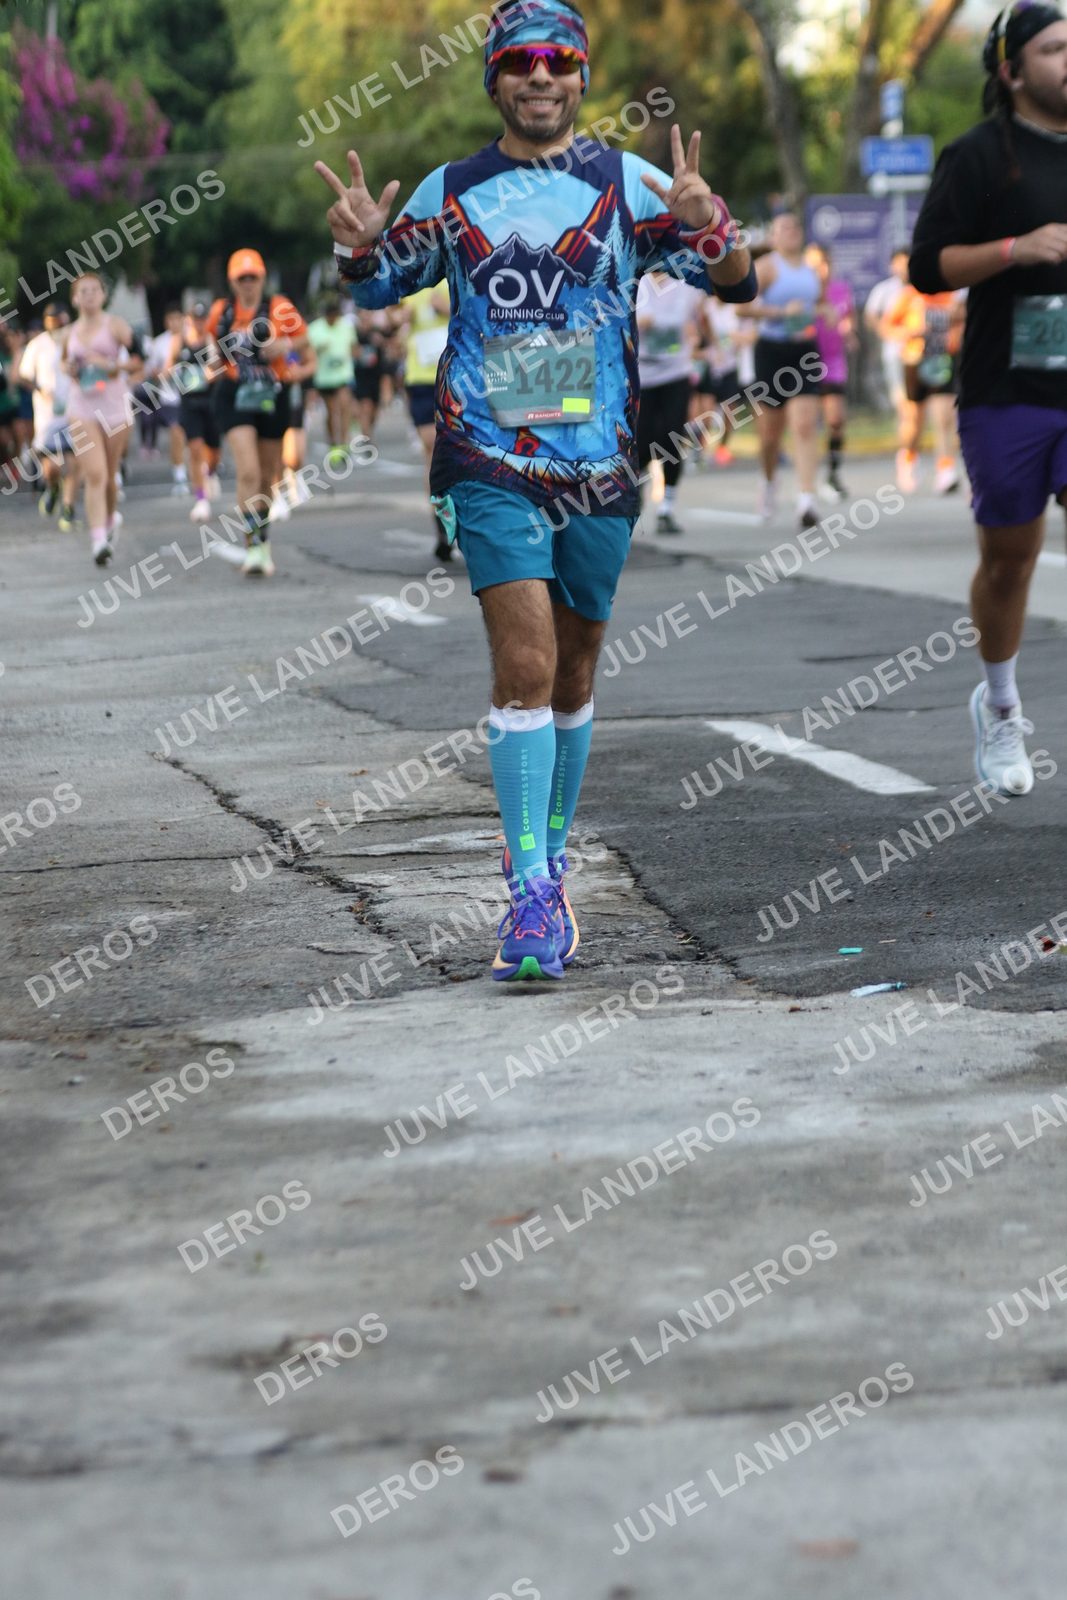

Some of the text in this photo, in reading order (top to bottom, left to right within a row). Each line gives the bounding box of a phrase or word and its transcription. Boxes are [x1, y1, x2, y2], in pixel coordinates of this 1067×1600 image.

[488, 268, 565, 308] OV
[490, 308, 565, 320] RUNNING CLUB
[515, 356, 592, 395] 1422
[521, 748, 530, 831] COMPRESSPORT
